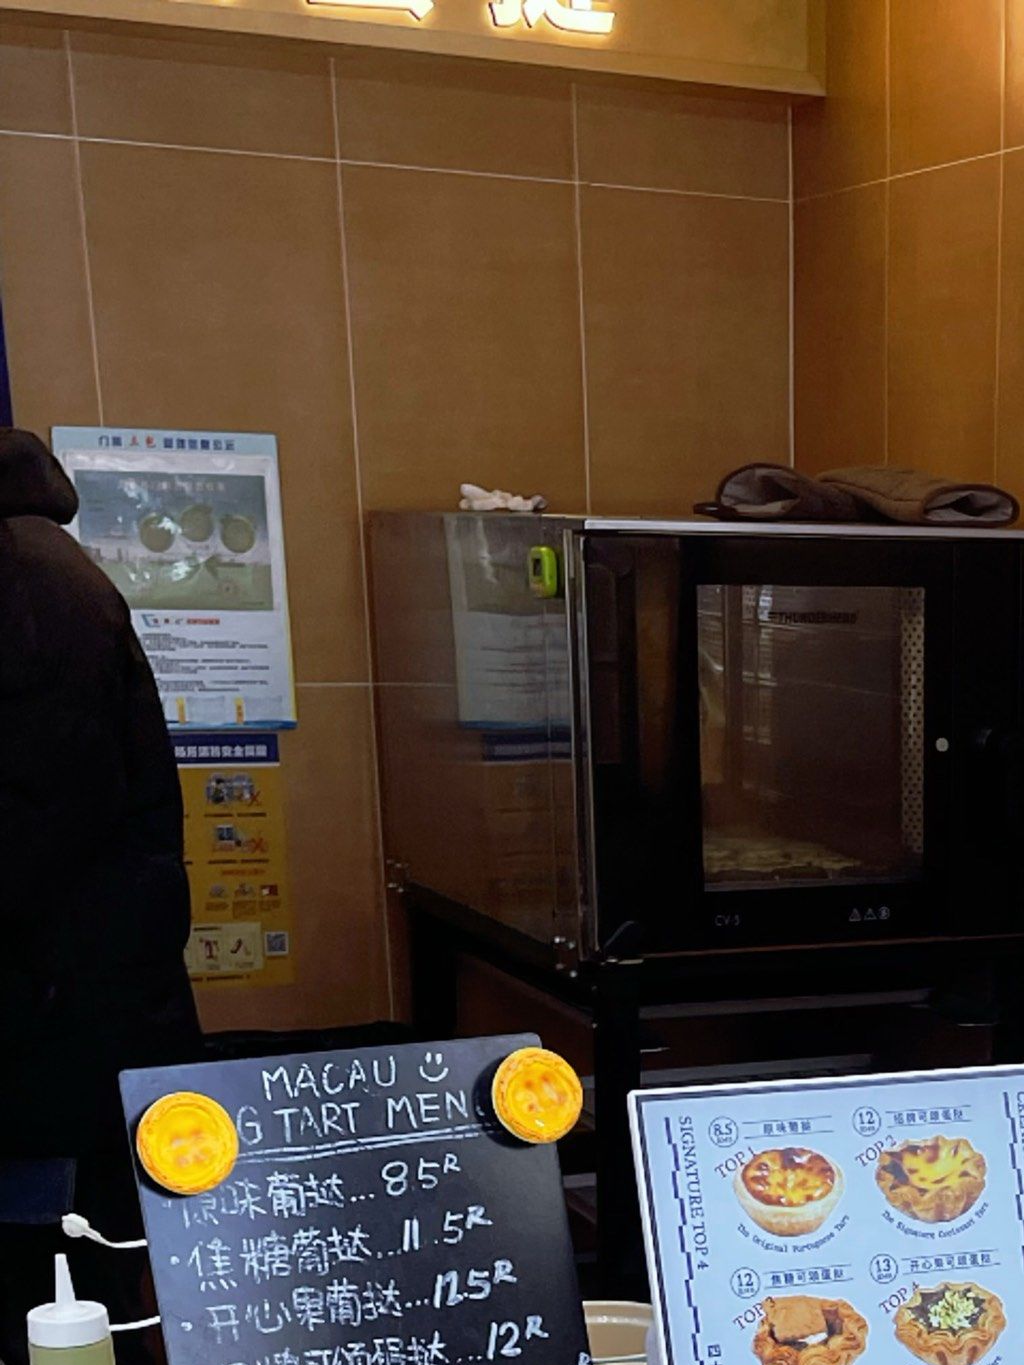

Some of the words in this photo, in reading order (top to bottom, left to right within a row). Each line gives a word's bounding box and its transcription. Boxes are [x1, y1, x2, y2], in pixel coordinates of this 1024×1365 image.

[262, 1055, 396, 1100] MACAU
[237, 1106, 263, 1145] G
[275, 1101, 360, 1142] TART
[387, 1090, 484, 1131] MEN
[859, 1111, 875, 1125] 12
[714, 1151, 747, 1178] TOP
[855, 1140, 884, 1167] TOP
[886, 1135, 897, 1147] 2
[679, 1116, 705, 1219] SIGNATURE
[692, 1222, 709, 1256] TOP
[698, 1260, 709, 1270] 4
[875, 1258, 891, 1272] 13
[737, 1273, 754, 1287] 12
[879, 1286, 909, 1313] TOP
[733, 1303, 769, 1330] TOP
